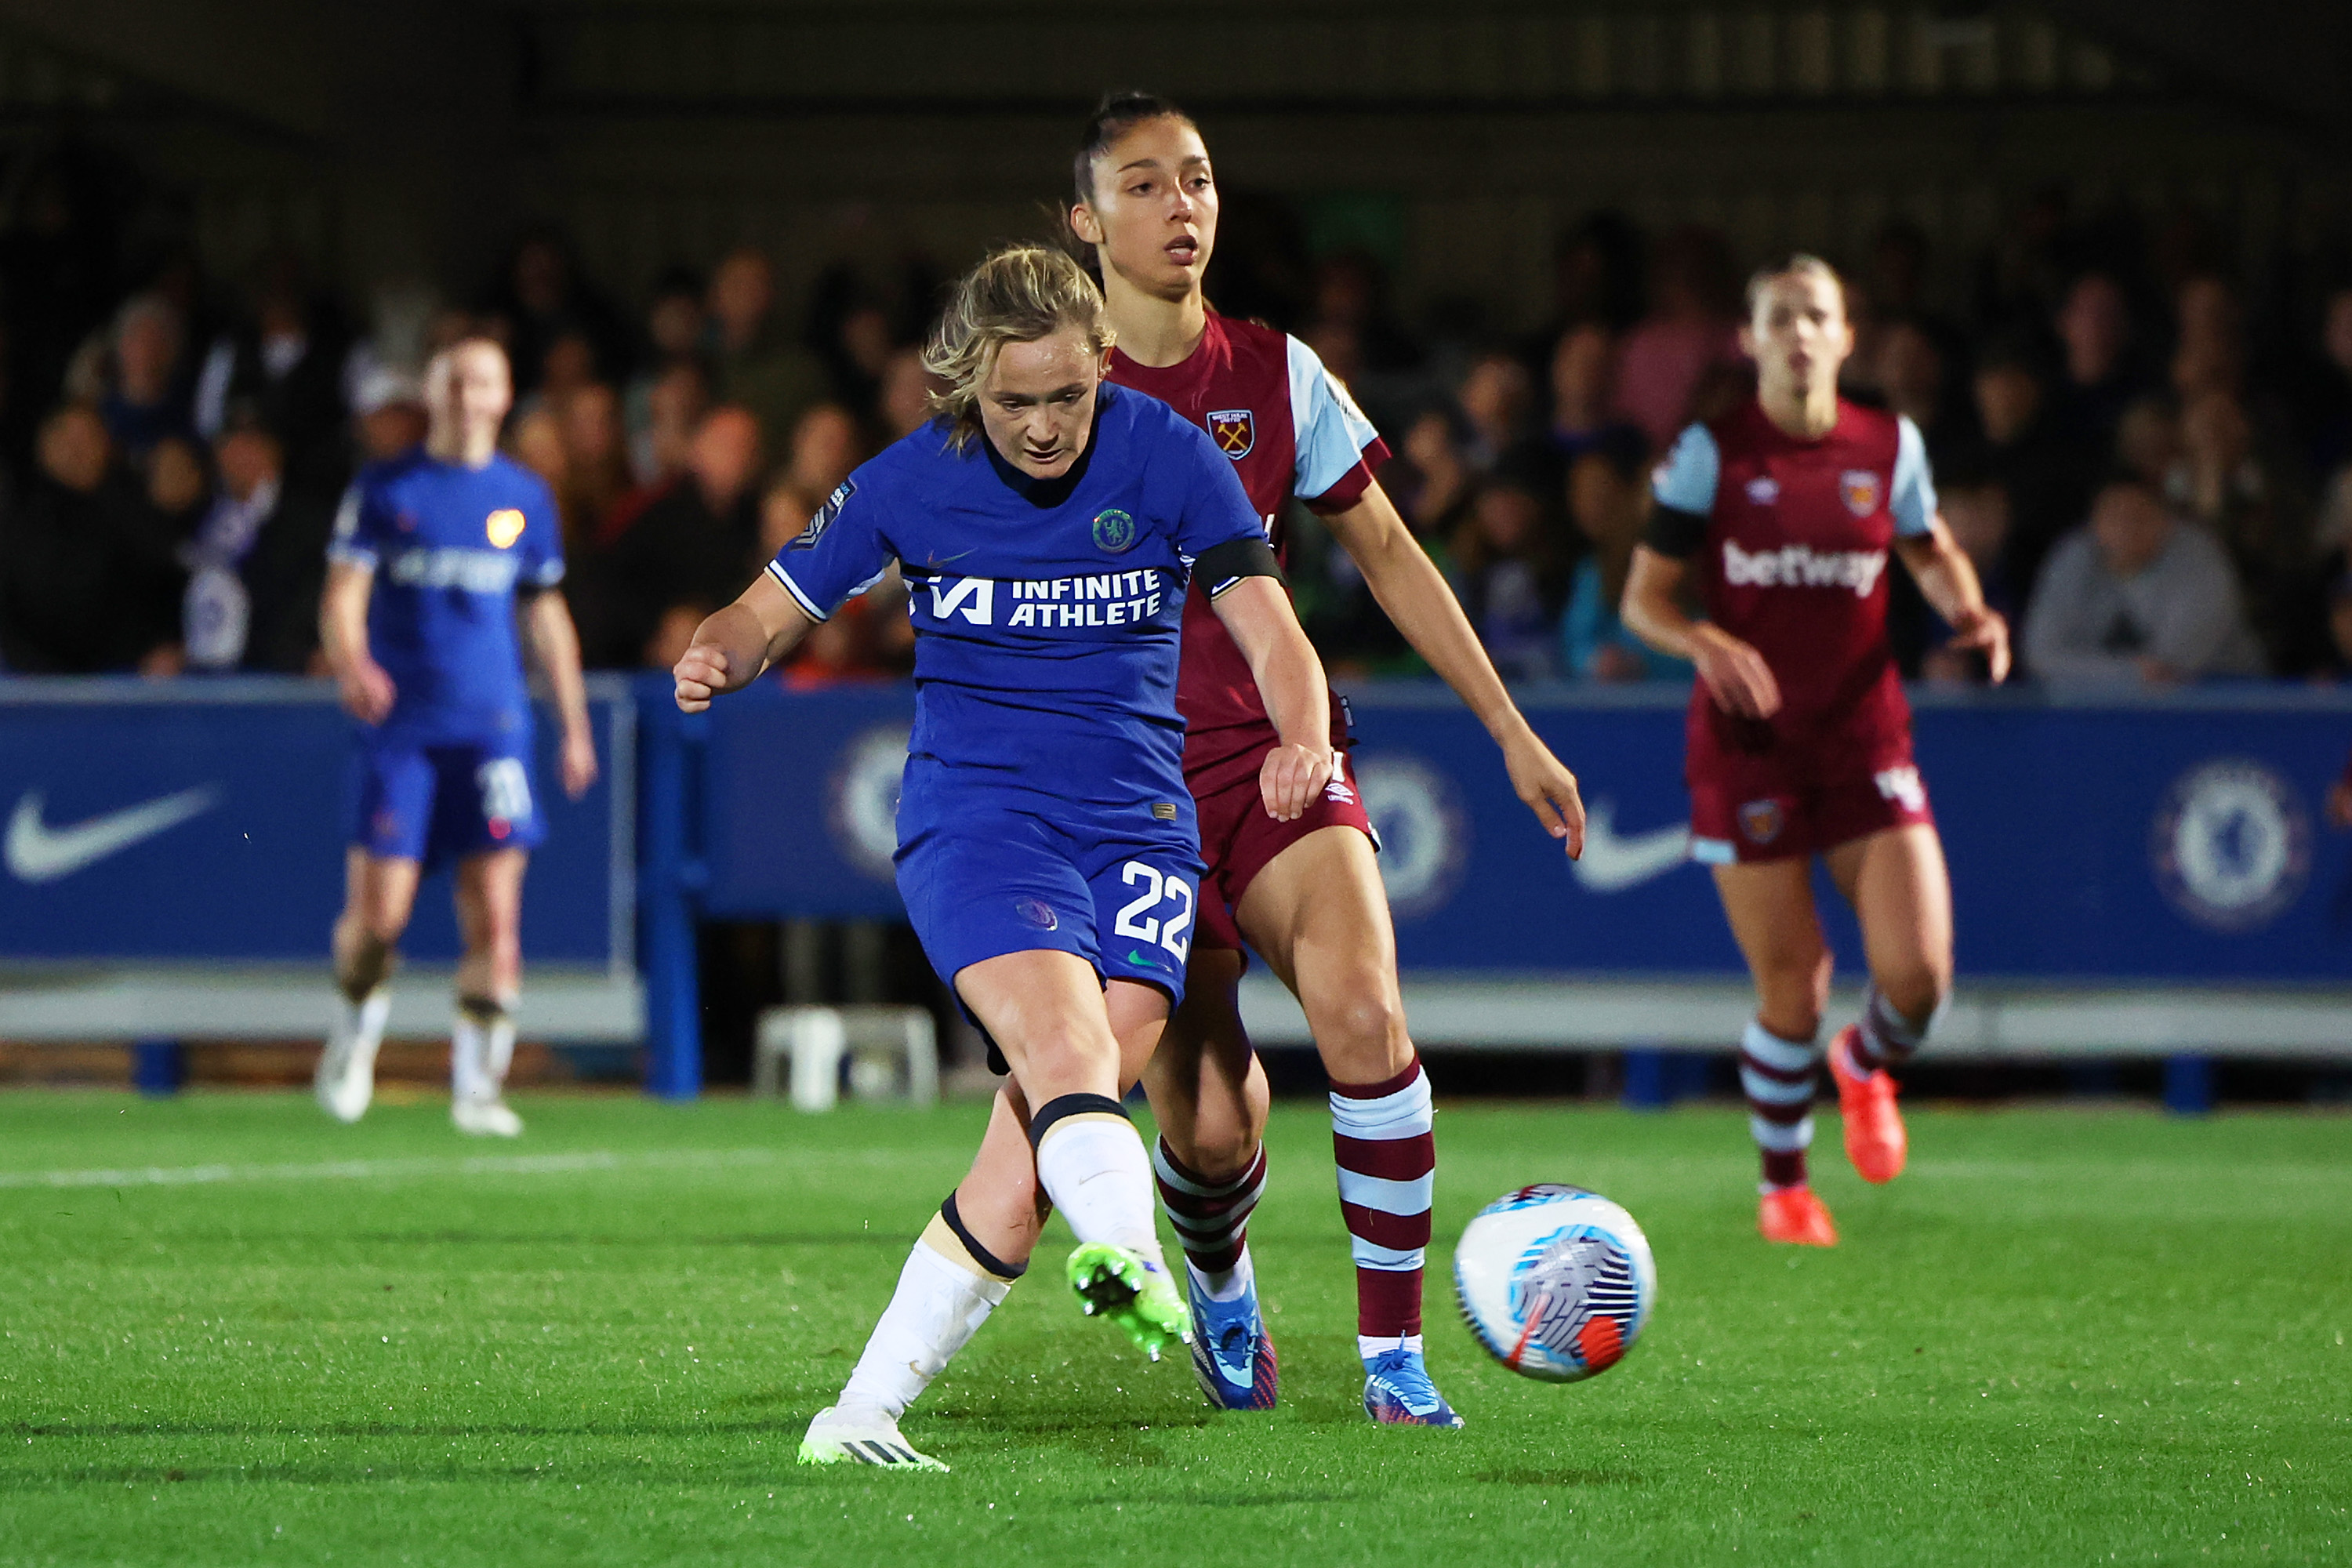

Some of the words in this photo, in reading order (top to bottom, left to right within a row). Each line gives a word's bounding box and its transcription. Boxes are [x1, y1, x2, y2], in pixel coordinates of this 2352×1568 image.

[1012, 569, 1160, 599] INFINITE
[1723, 539, 1888, 598] betway
[1007, 592, 1160, 627] ATHLETE
[1114, 860, 1192, 966] 22
